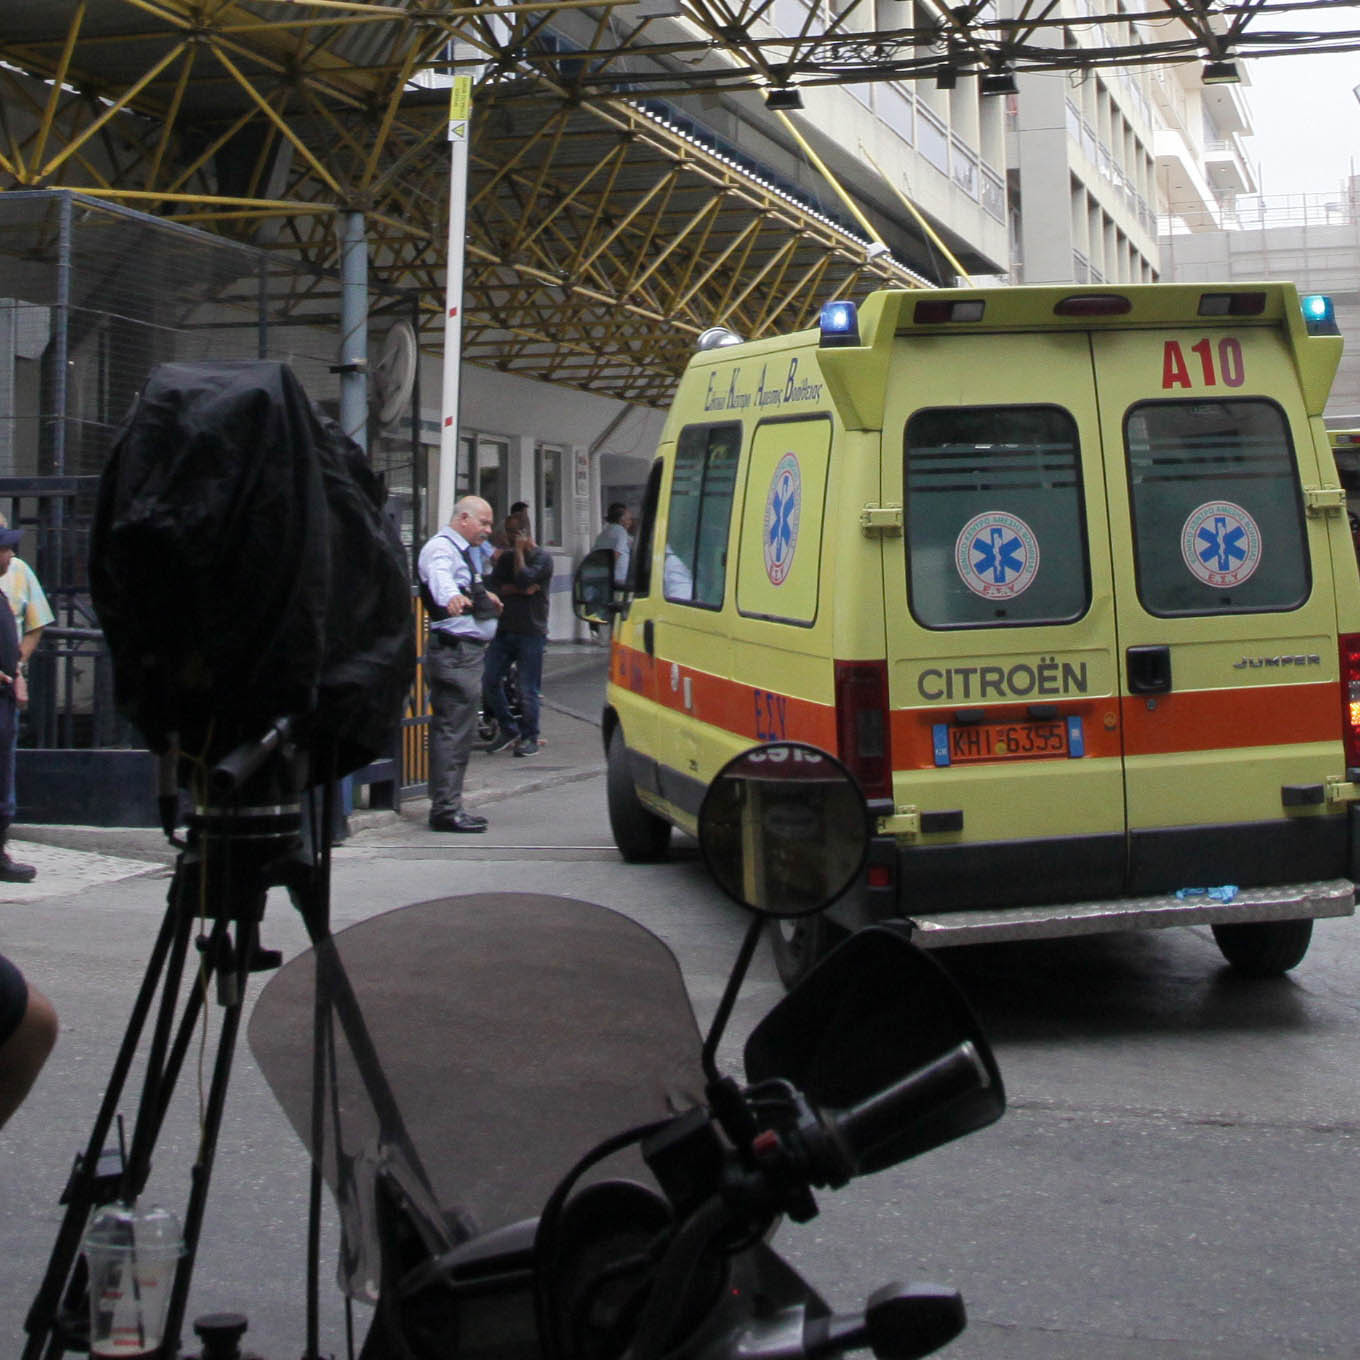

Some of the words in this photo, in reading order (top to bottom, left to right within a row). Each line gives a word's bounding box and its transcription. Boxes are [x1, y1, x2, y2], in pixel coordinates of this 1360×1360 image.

[1162, 337, 1245, 389] A10
[918, 656, 1088, 701] CITROËN
[1232, 654, 1321, 669] JUMPER
[1006, 722, 1064, 753] 6355
